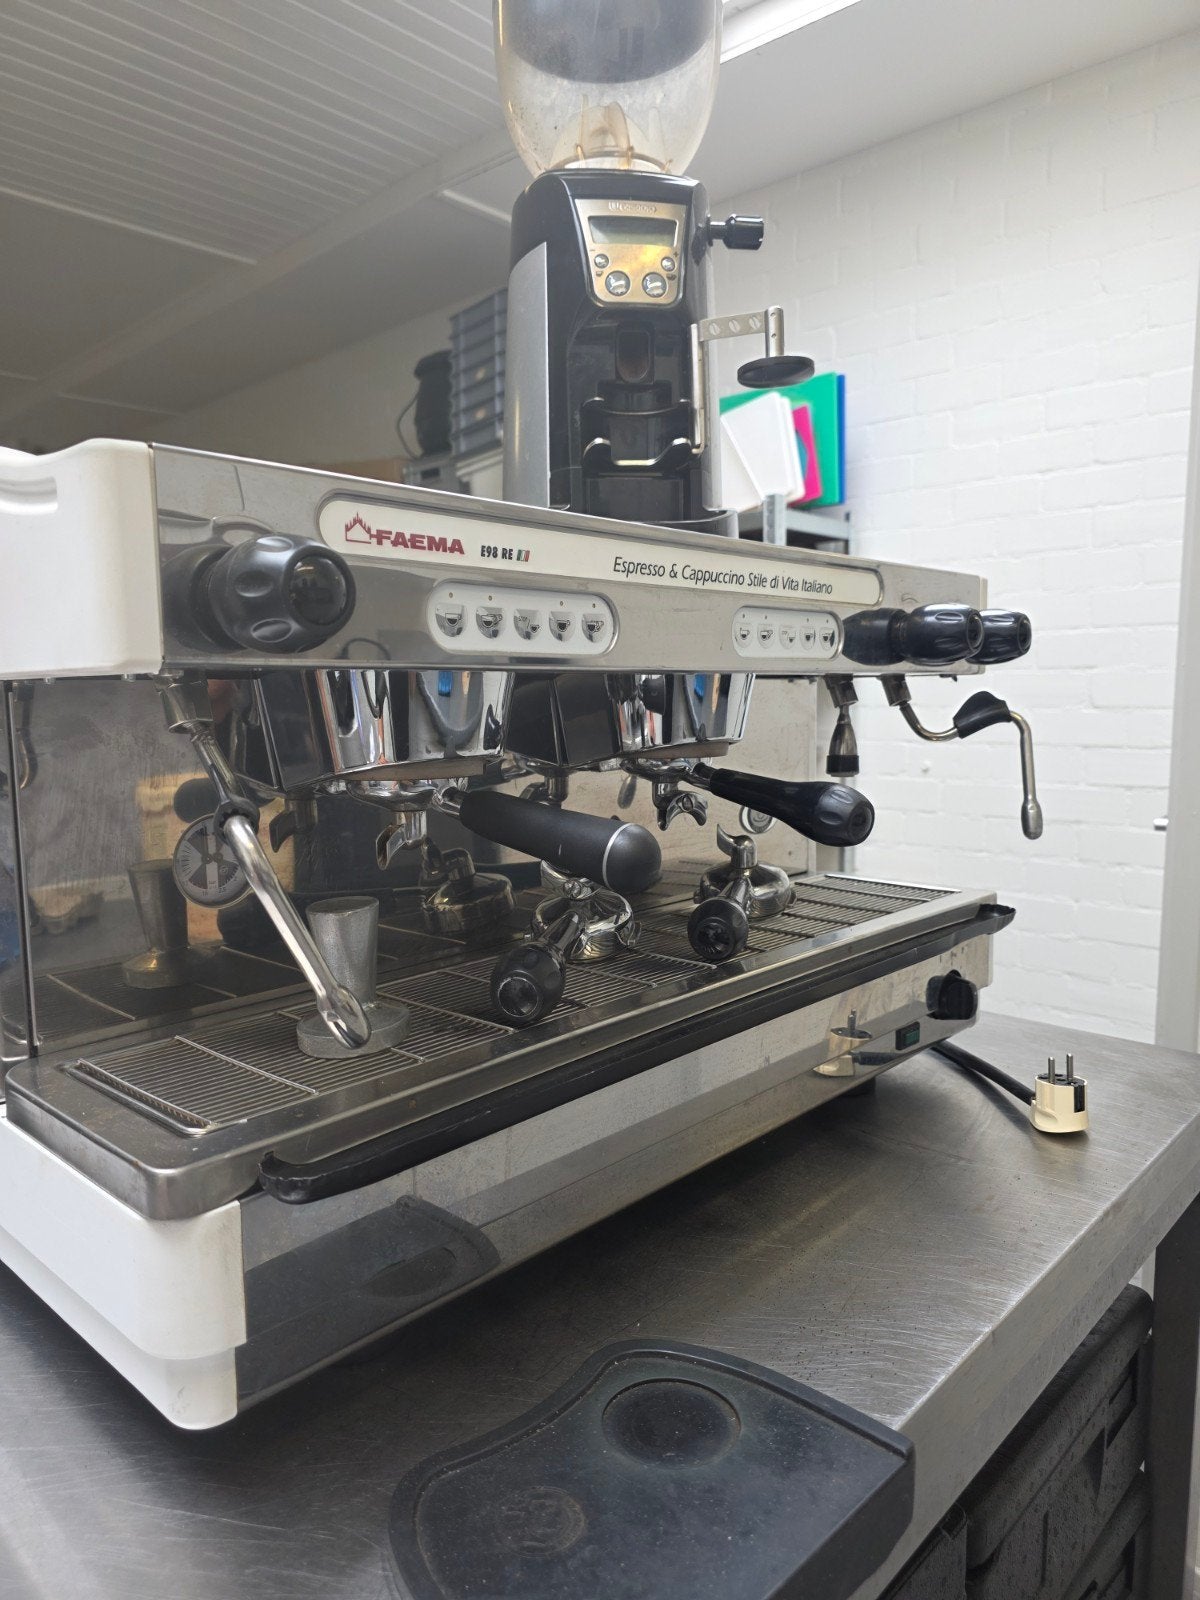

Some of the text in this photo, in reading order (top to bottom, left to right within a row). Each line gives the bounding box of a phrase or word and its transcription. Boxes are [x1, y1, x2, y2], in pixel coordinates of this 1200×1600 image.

[375, 529, 465, 555] FAEMA
[480, 545, 513, 560] E98 RE
[613, 556, 833, 595] Espresso & Cappuccino Stile di Vita Italiano
